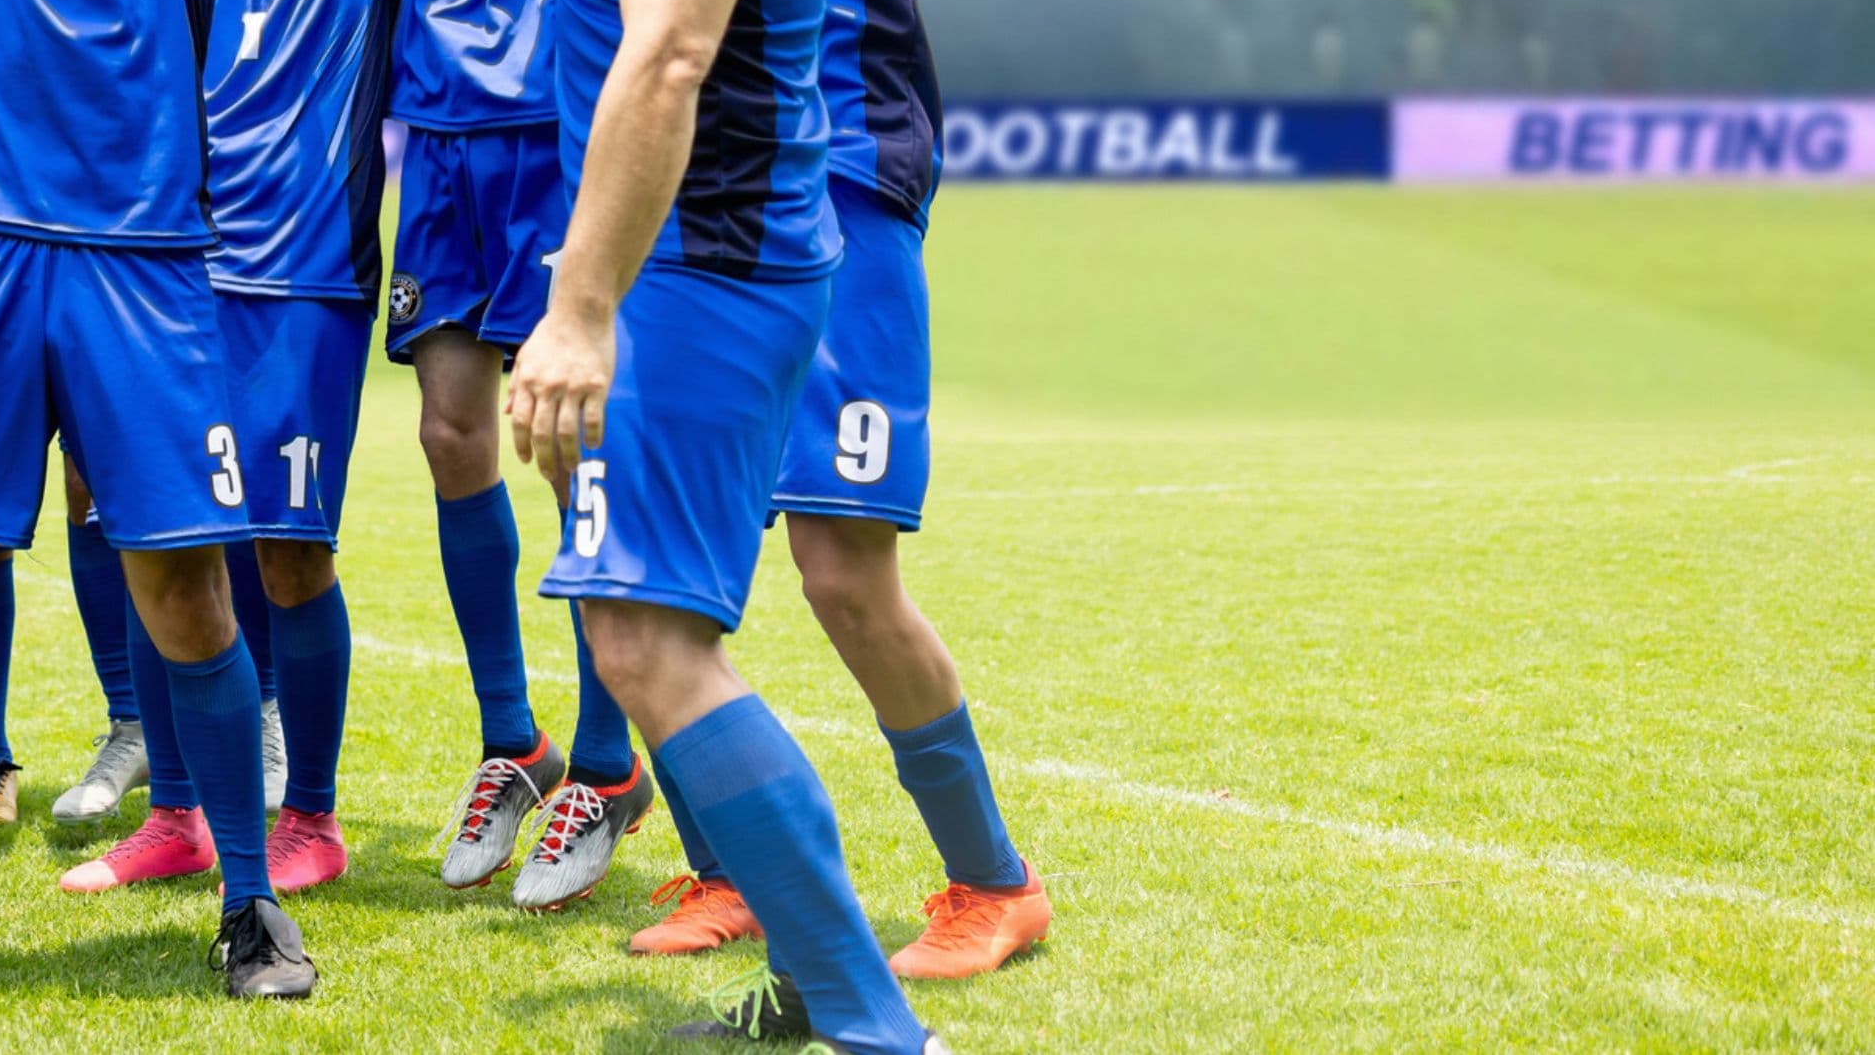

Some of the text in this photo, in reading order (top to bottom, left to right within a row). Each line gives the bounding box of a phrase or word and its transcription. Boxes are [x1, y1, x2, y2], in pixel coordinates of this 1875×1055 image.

[943, 109, 1298, 175] OOTBALL
[1508, 108, 1851, 175] BETTING
[206, 425, 244, 506] 3
[835, 400, 891, 483] 9
[574, 459, 608, 559] 5
